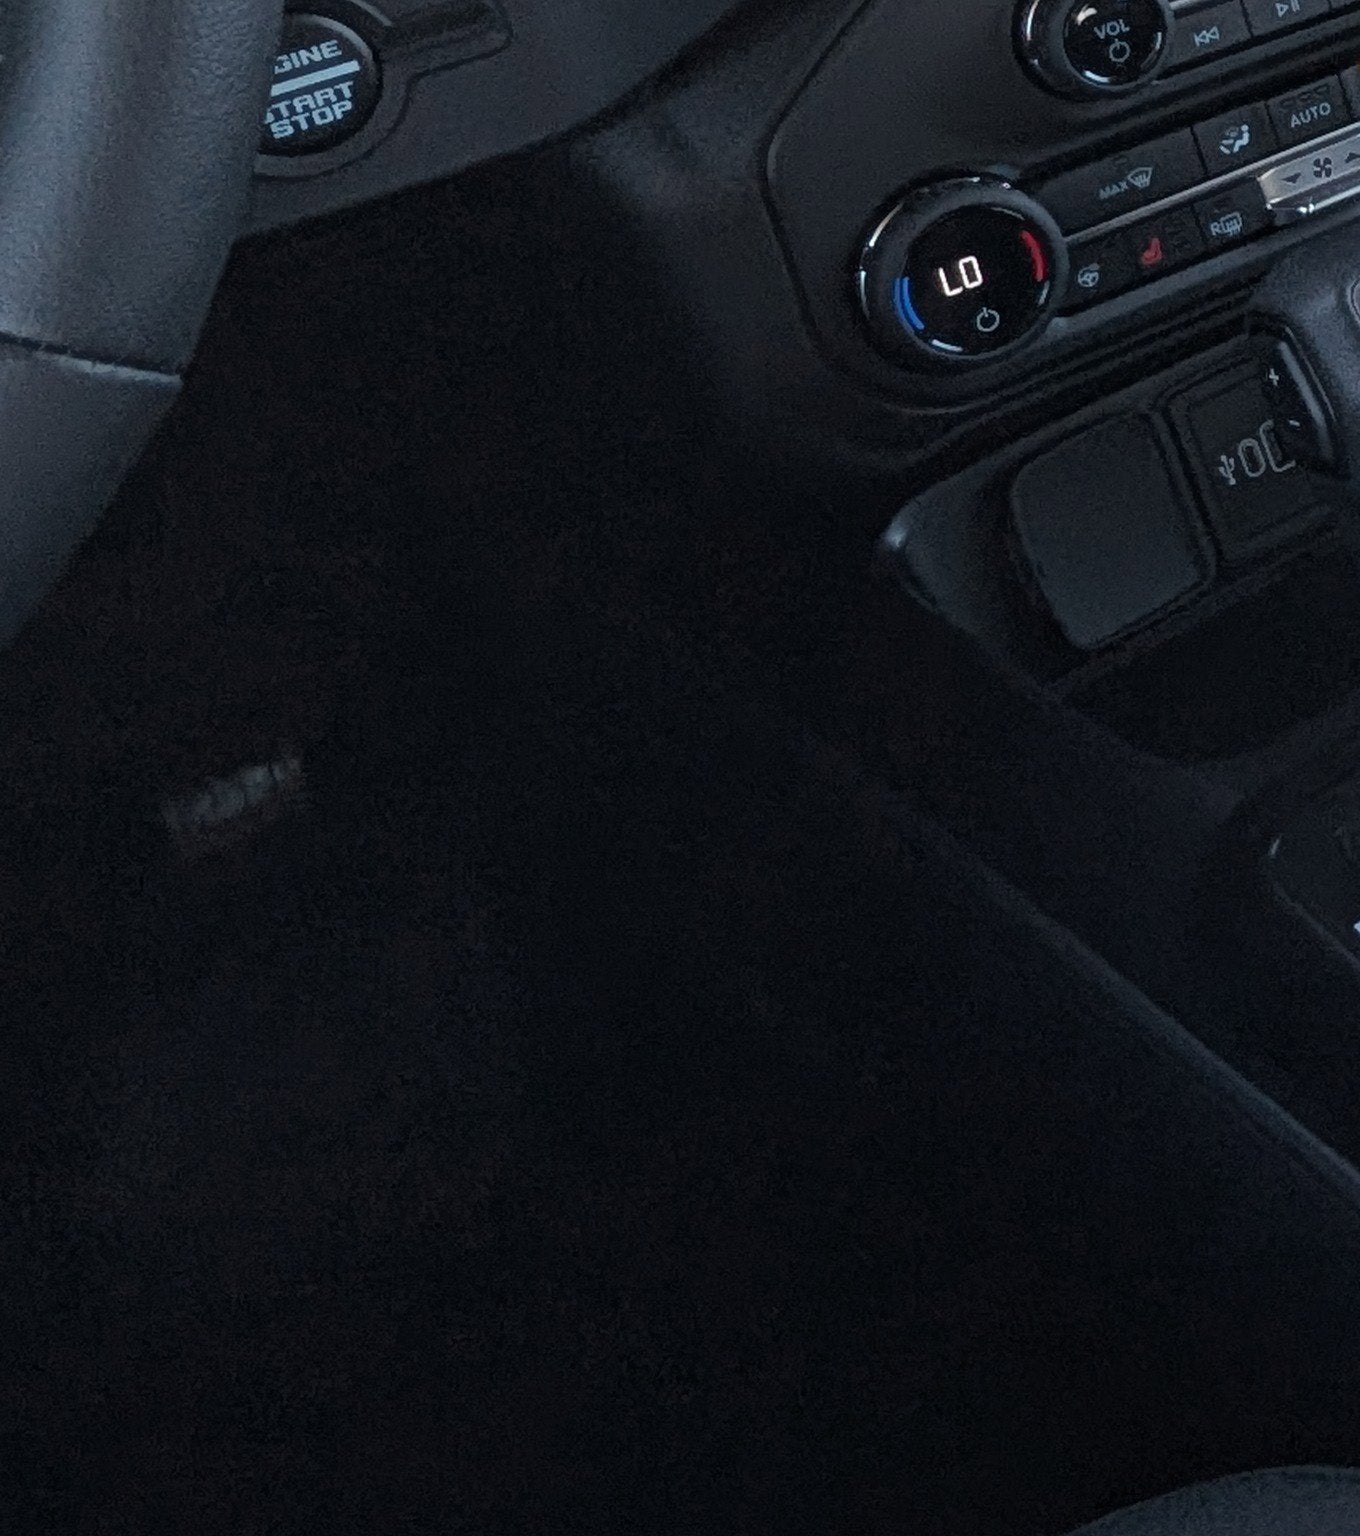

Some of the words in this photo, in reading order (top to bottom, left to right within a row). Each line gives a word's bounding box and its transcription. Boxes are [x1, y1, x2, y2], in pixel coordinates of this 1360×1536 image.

[1093, 18, 1130, 41] VOL
[270, 100, 353, 139] STOP
[1289, 102, 1332, 129] AUTO
[1098, 179, 1128, 201] MAX
[938, 255, 984, 297] LO
